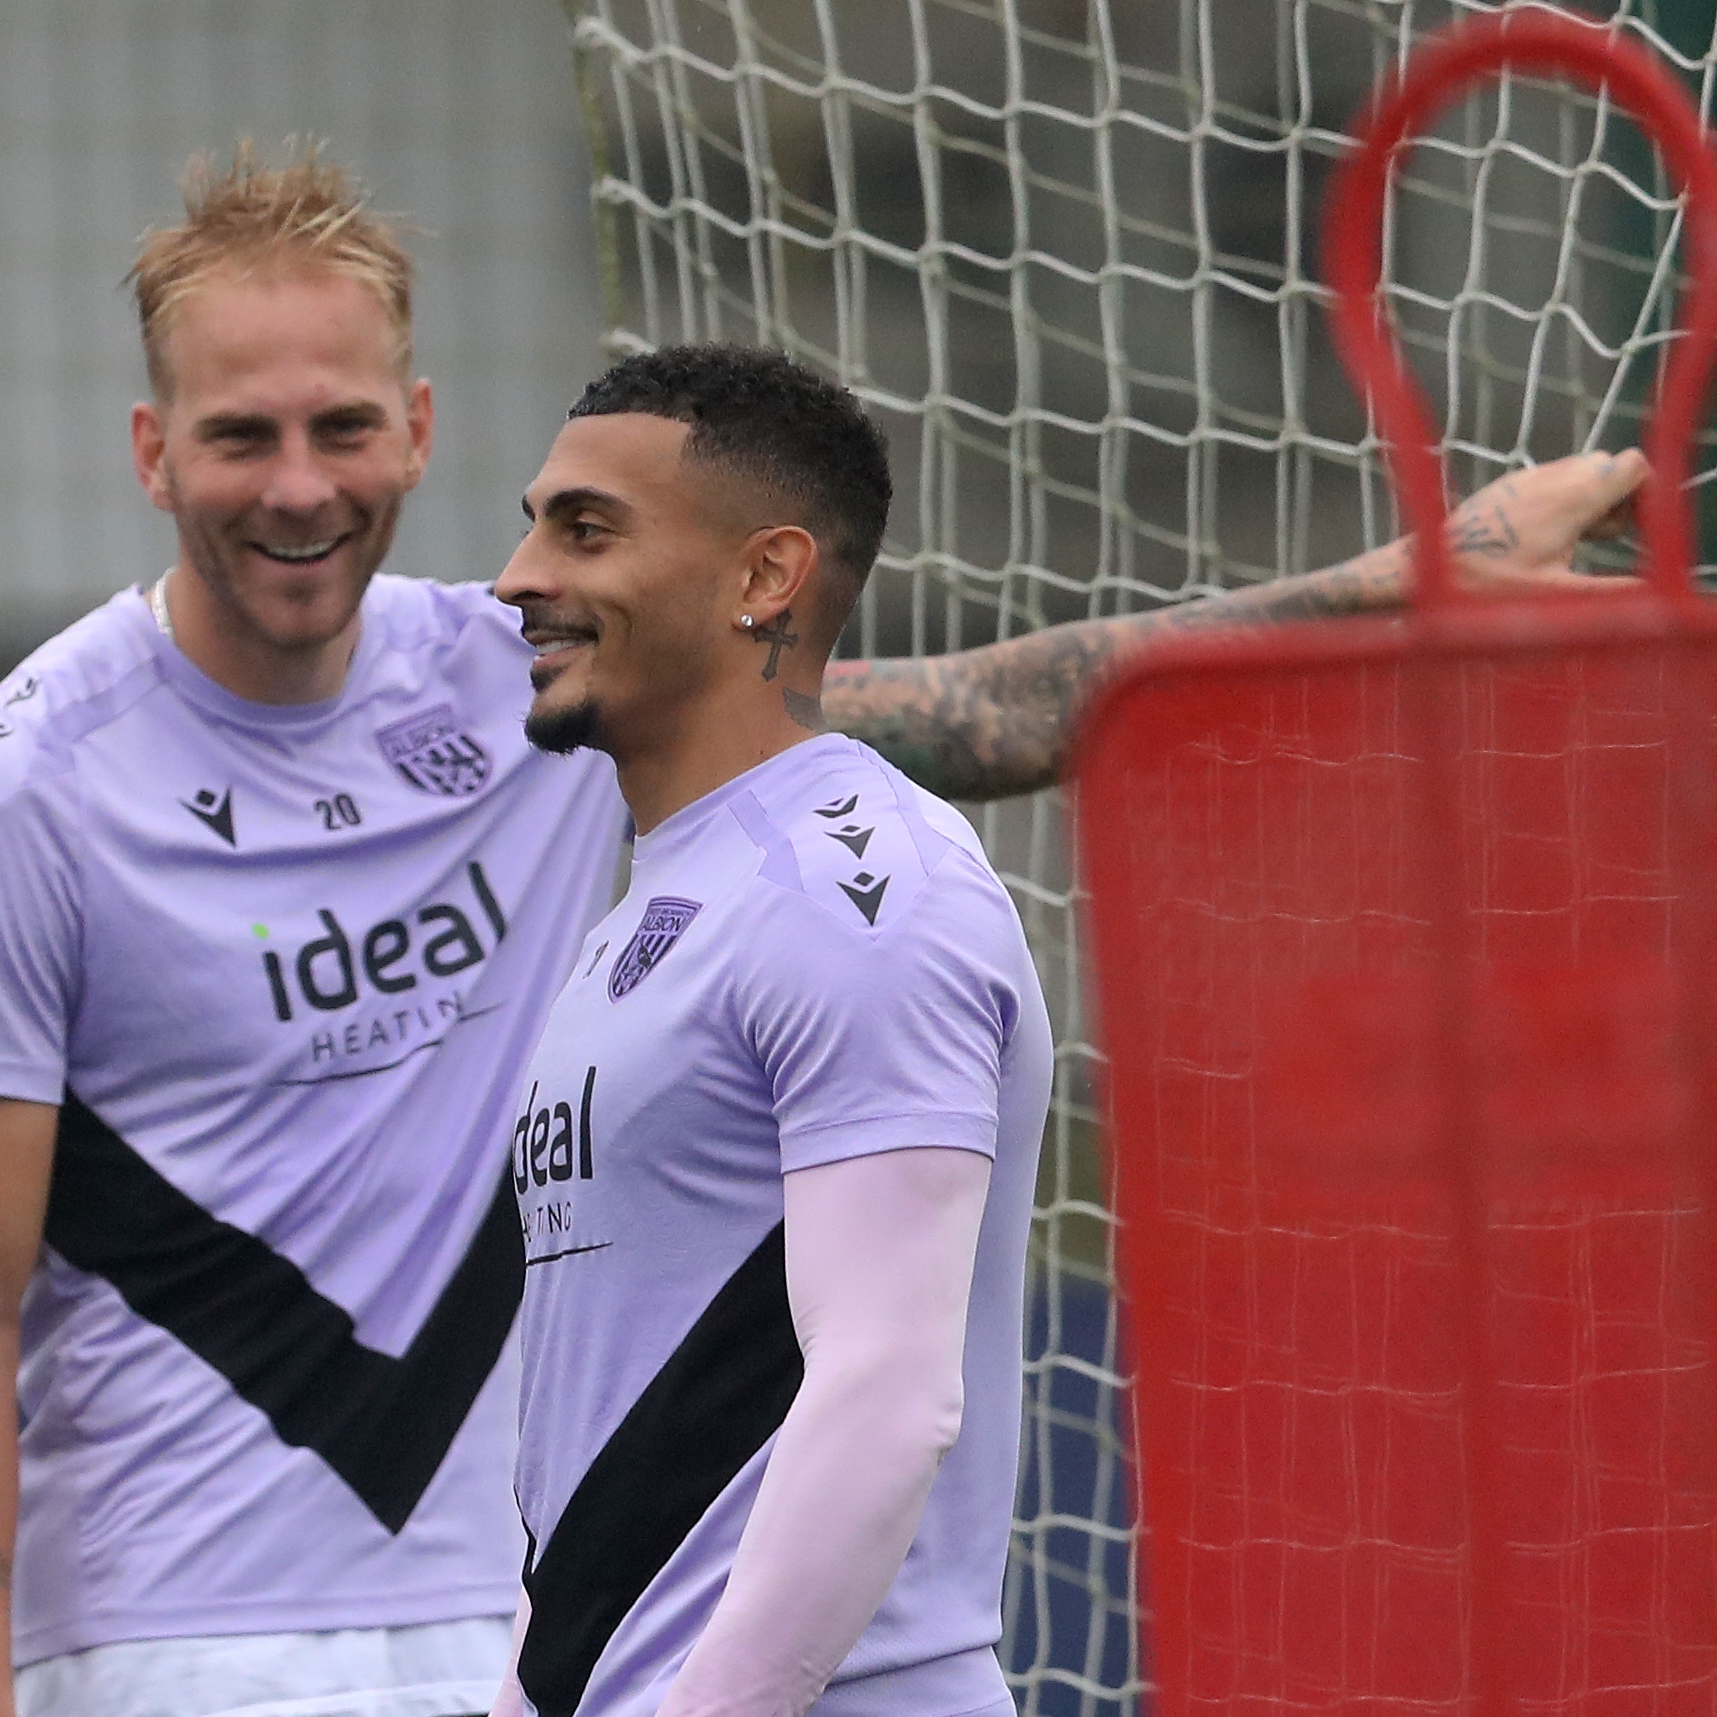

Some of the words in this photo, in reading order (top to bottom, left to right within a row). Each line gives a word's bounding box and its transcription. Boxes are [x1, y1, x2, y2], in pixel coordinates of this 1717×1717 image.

[315, 792, 361, 830] 20
[252, 861, 507, 1022] ideal
[310, 989, 465, 1062] HEATIN
[514, 1066, 597, 1195] deal
